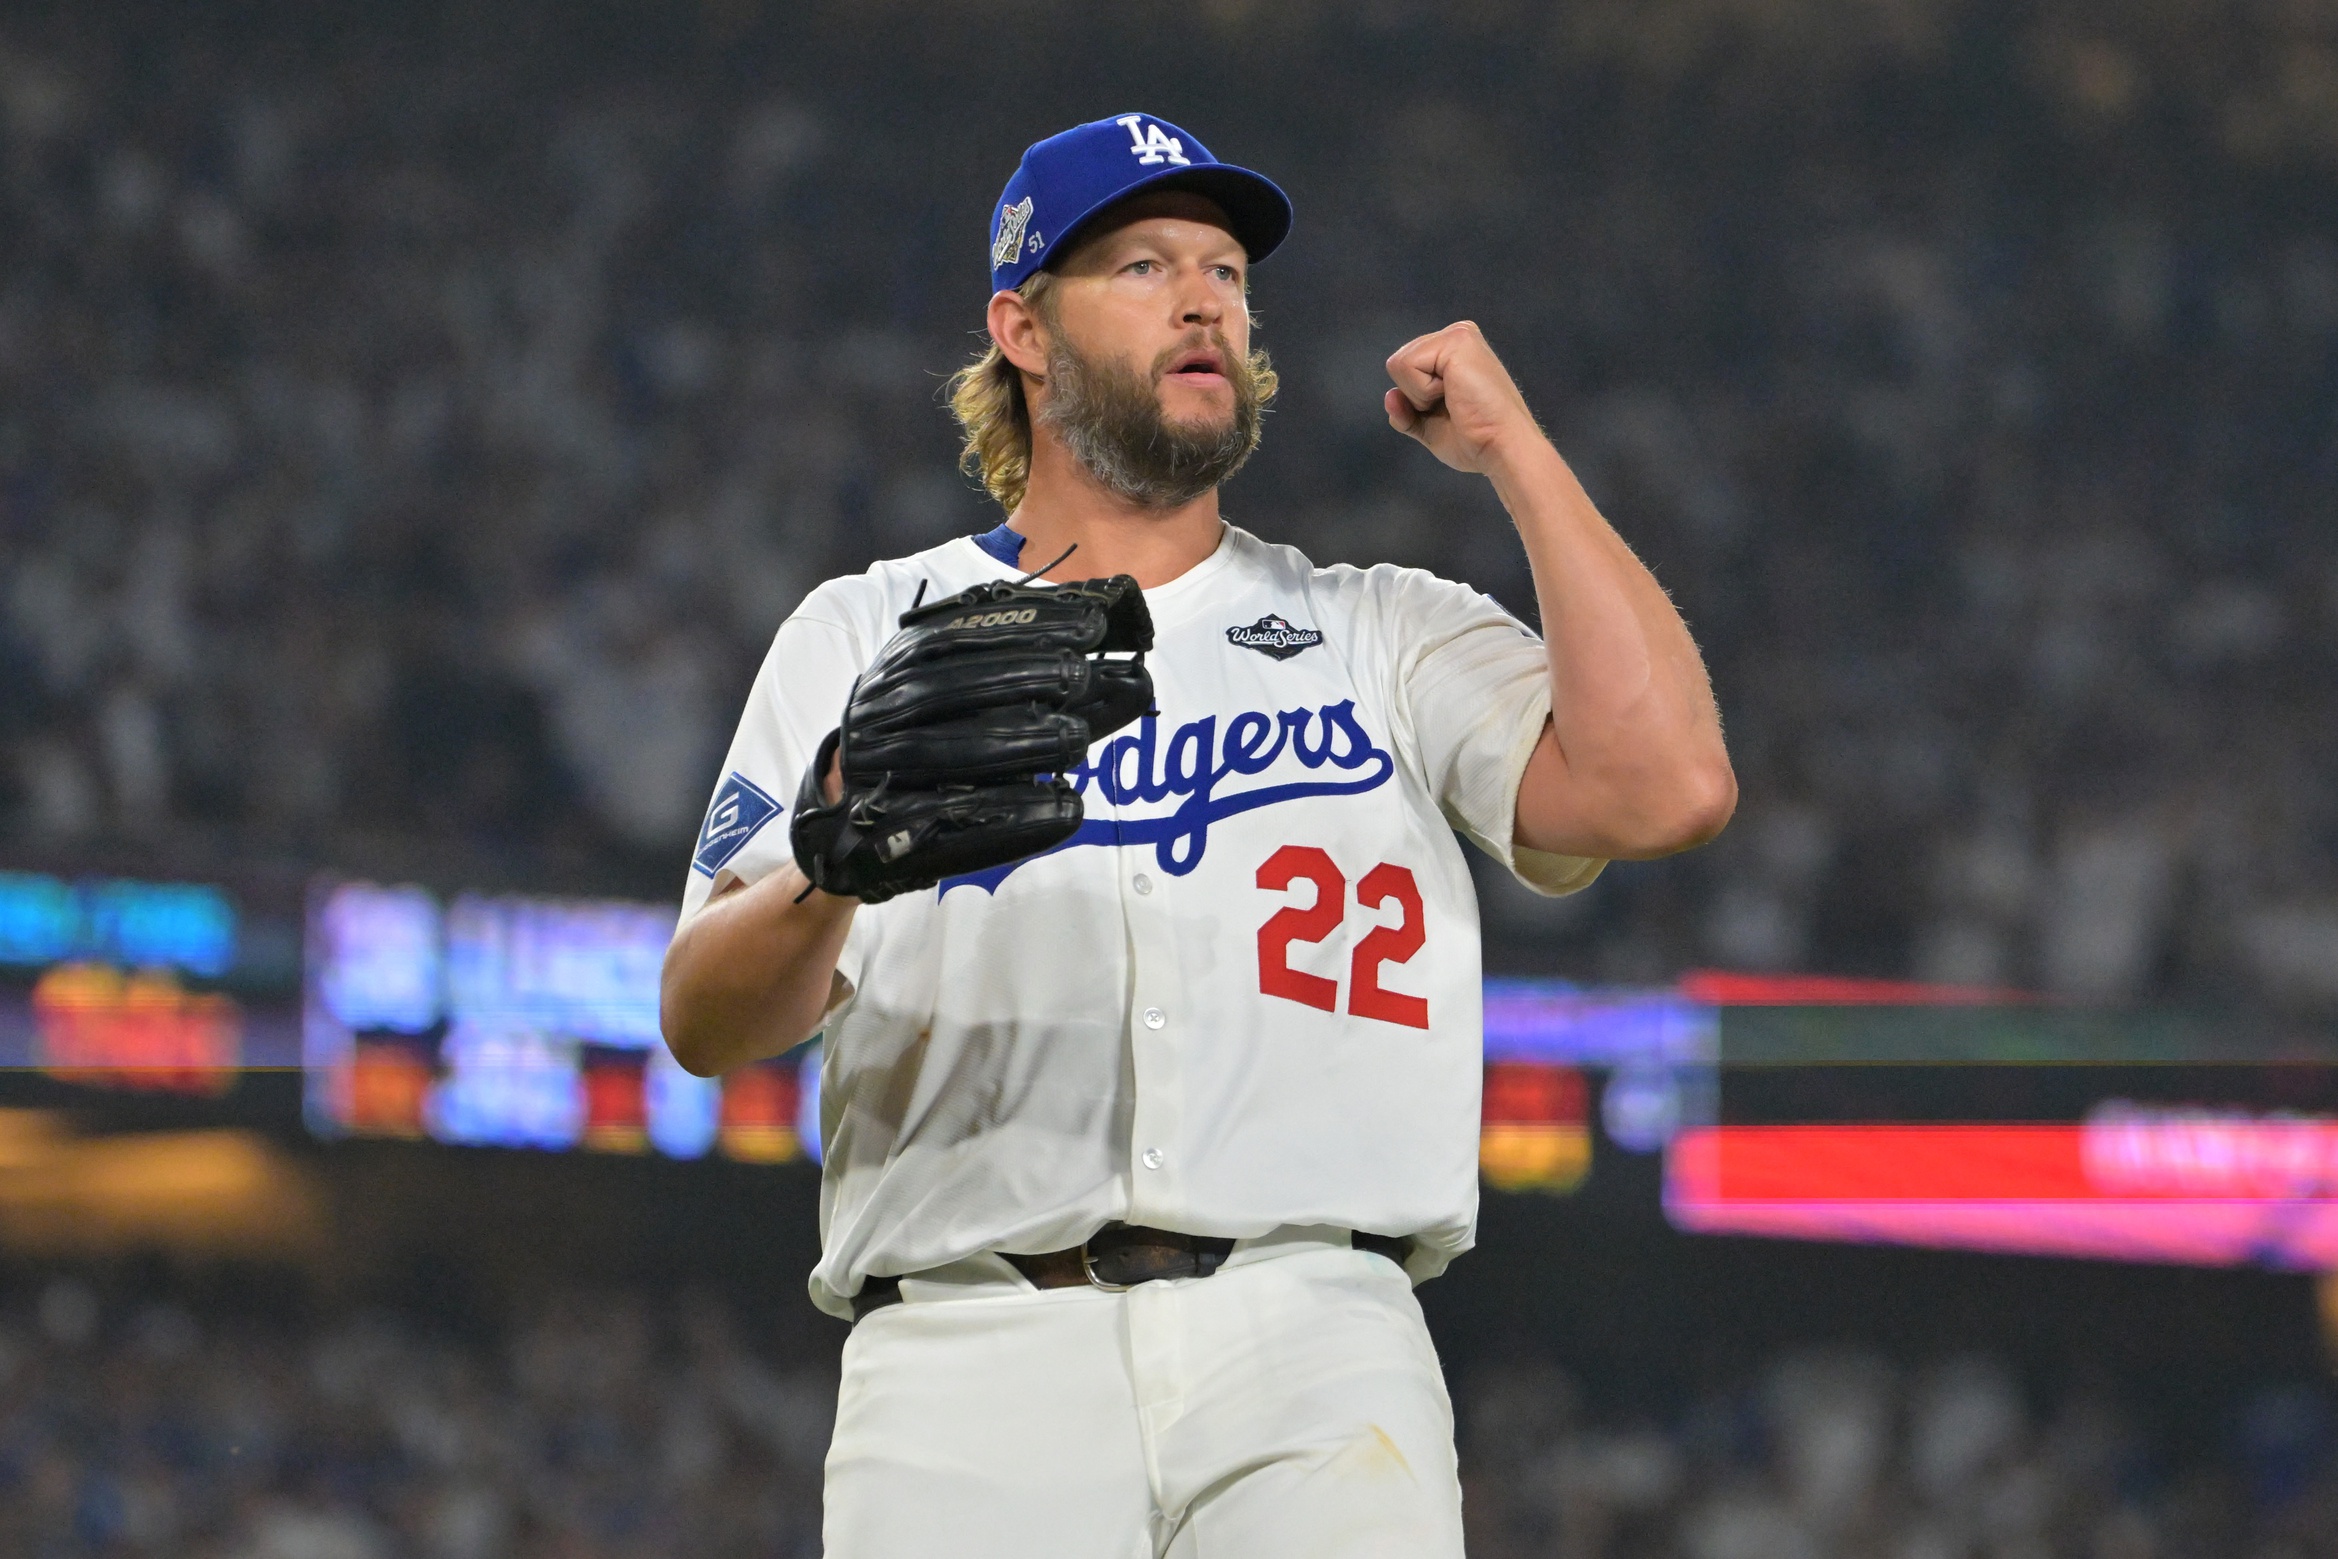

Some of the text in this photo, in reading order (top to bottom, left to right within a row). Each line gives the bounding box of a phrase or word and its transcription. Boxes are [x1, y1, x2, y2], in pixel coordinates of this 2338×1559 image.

[1116, 115, 1191, 166] LA
[1028, 230, 1045, 254] 51
[944, 608, 1038, 631] A2000
[1255, 844, 1429, 1030] 22
